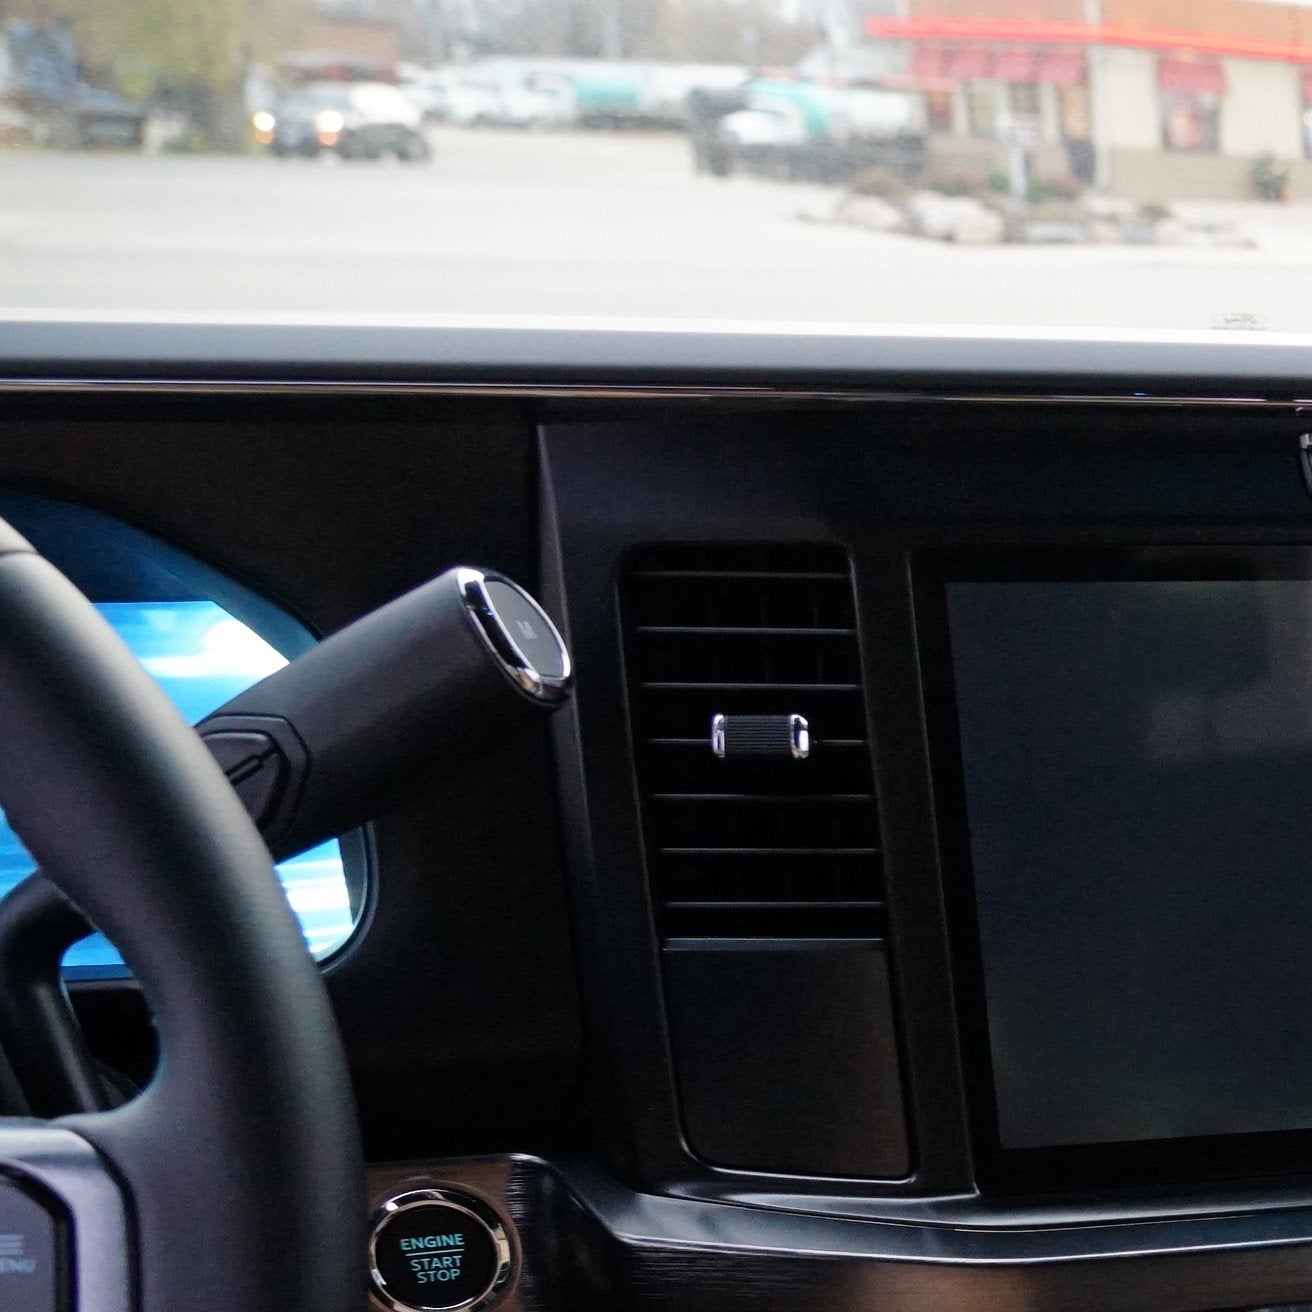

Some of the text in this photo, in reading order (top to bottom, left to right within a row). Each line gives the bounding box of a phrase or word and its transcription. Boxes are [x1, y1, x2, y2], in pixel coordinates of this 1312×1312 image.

[400, 1233, 465, 1250] ENGINE
[410, 1255, 463, 1271] START
[417, 1269, 461, 1284] STOP
